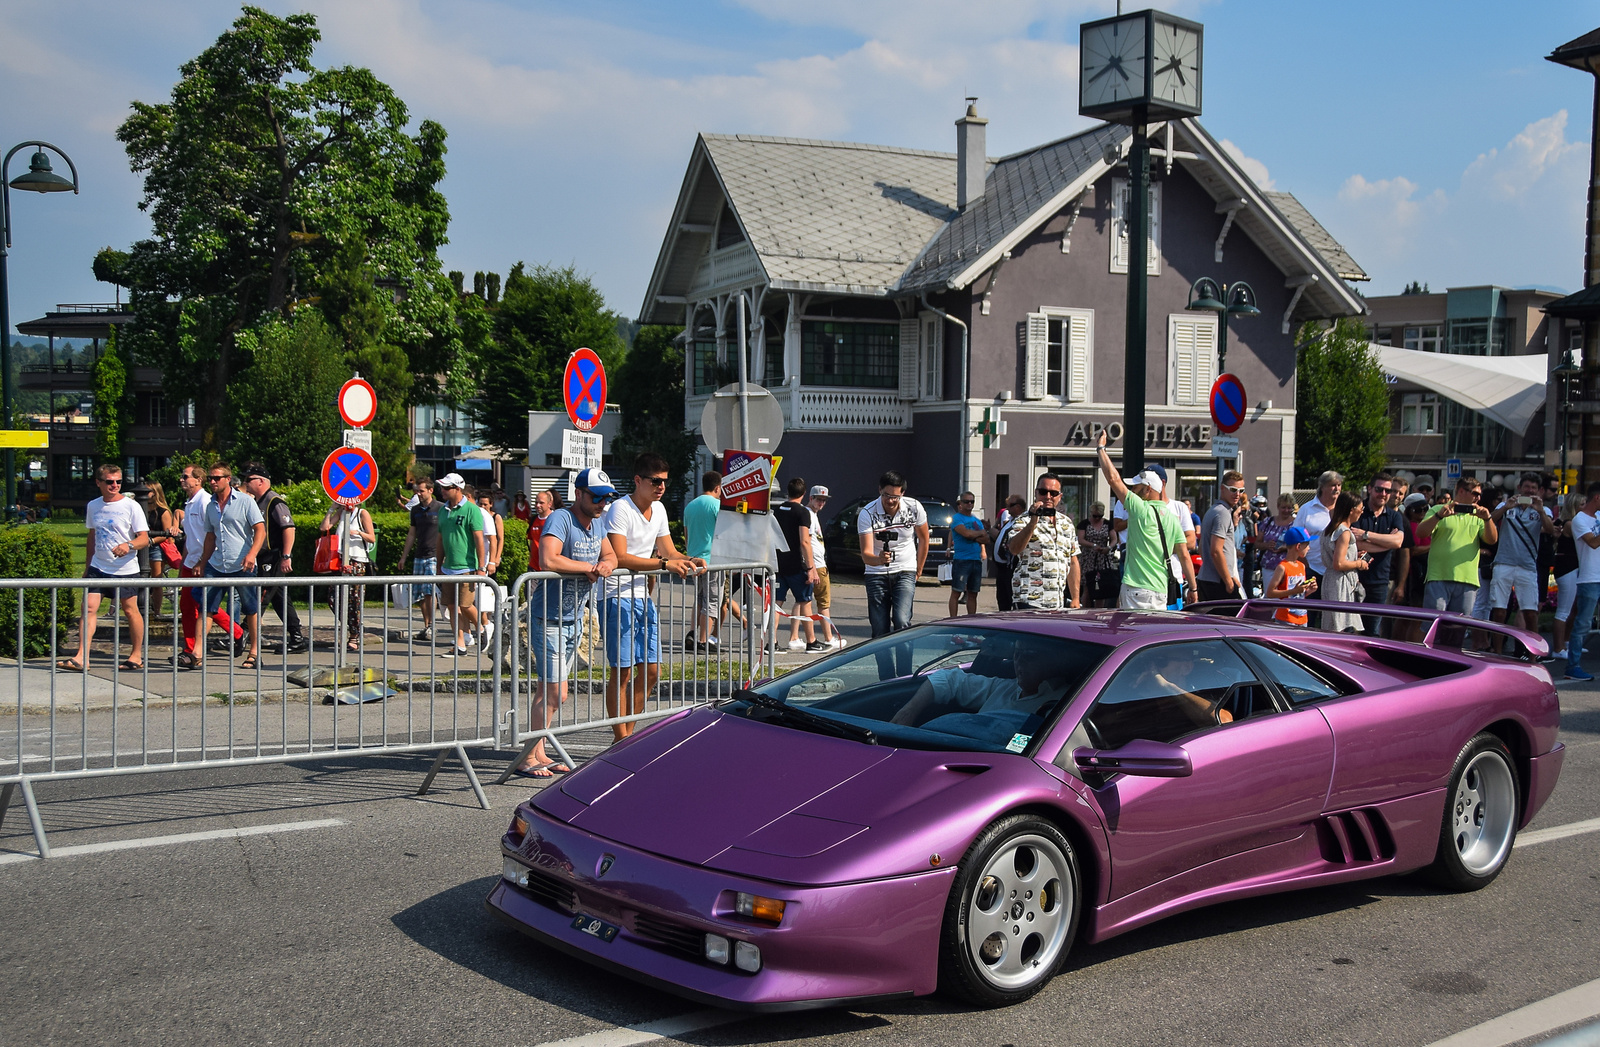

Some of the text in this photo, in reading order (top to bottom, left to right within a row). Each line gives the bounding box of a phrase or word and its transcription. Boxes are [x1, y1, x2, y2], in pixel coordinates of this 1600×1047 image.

[576, 418, 592, 429] ANFANG
[1070, 420, 1212, 442] APOHEKE
[729, 459, 749, 472] KULTUR
[724, 474, 764, 494] KURIER
[336, 496, 360, 504] ANFANG
[456, 516, 465, 525] H
